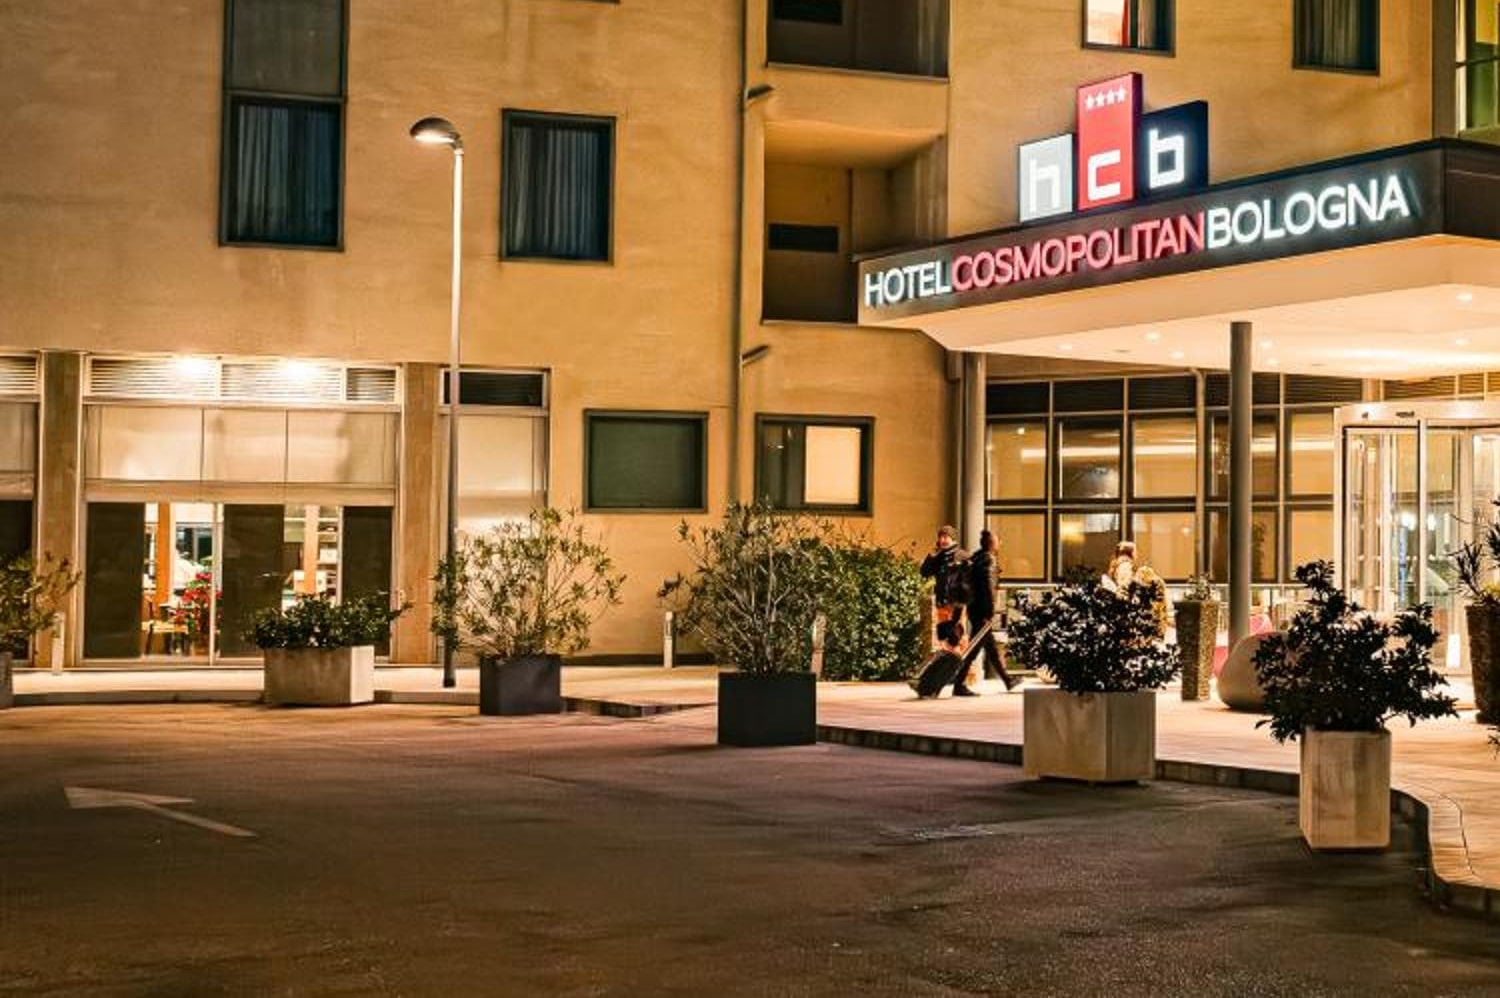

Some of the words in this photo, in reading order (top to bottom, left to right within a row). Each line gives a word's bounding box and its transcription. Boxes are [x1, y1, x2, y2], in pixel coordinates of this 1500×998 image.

[864, 260, 952, 307] HOTEL
[951, 211, 1205, 292] COSMOPOLITAN
[1206, 173, 1411, 250] BOLOGNA
